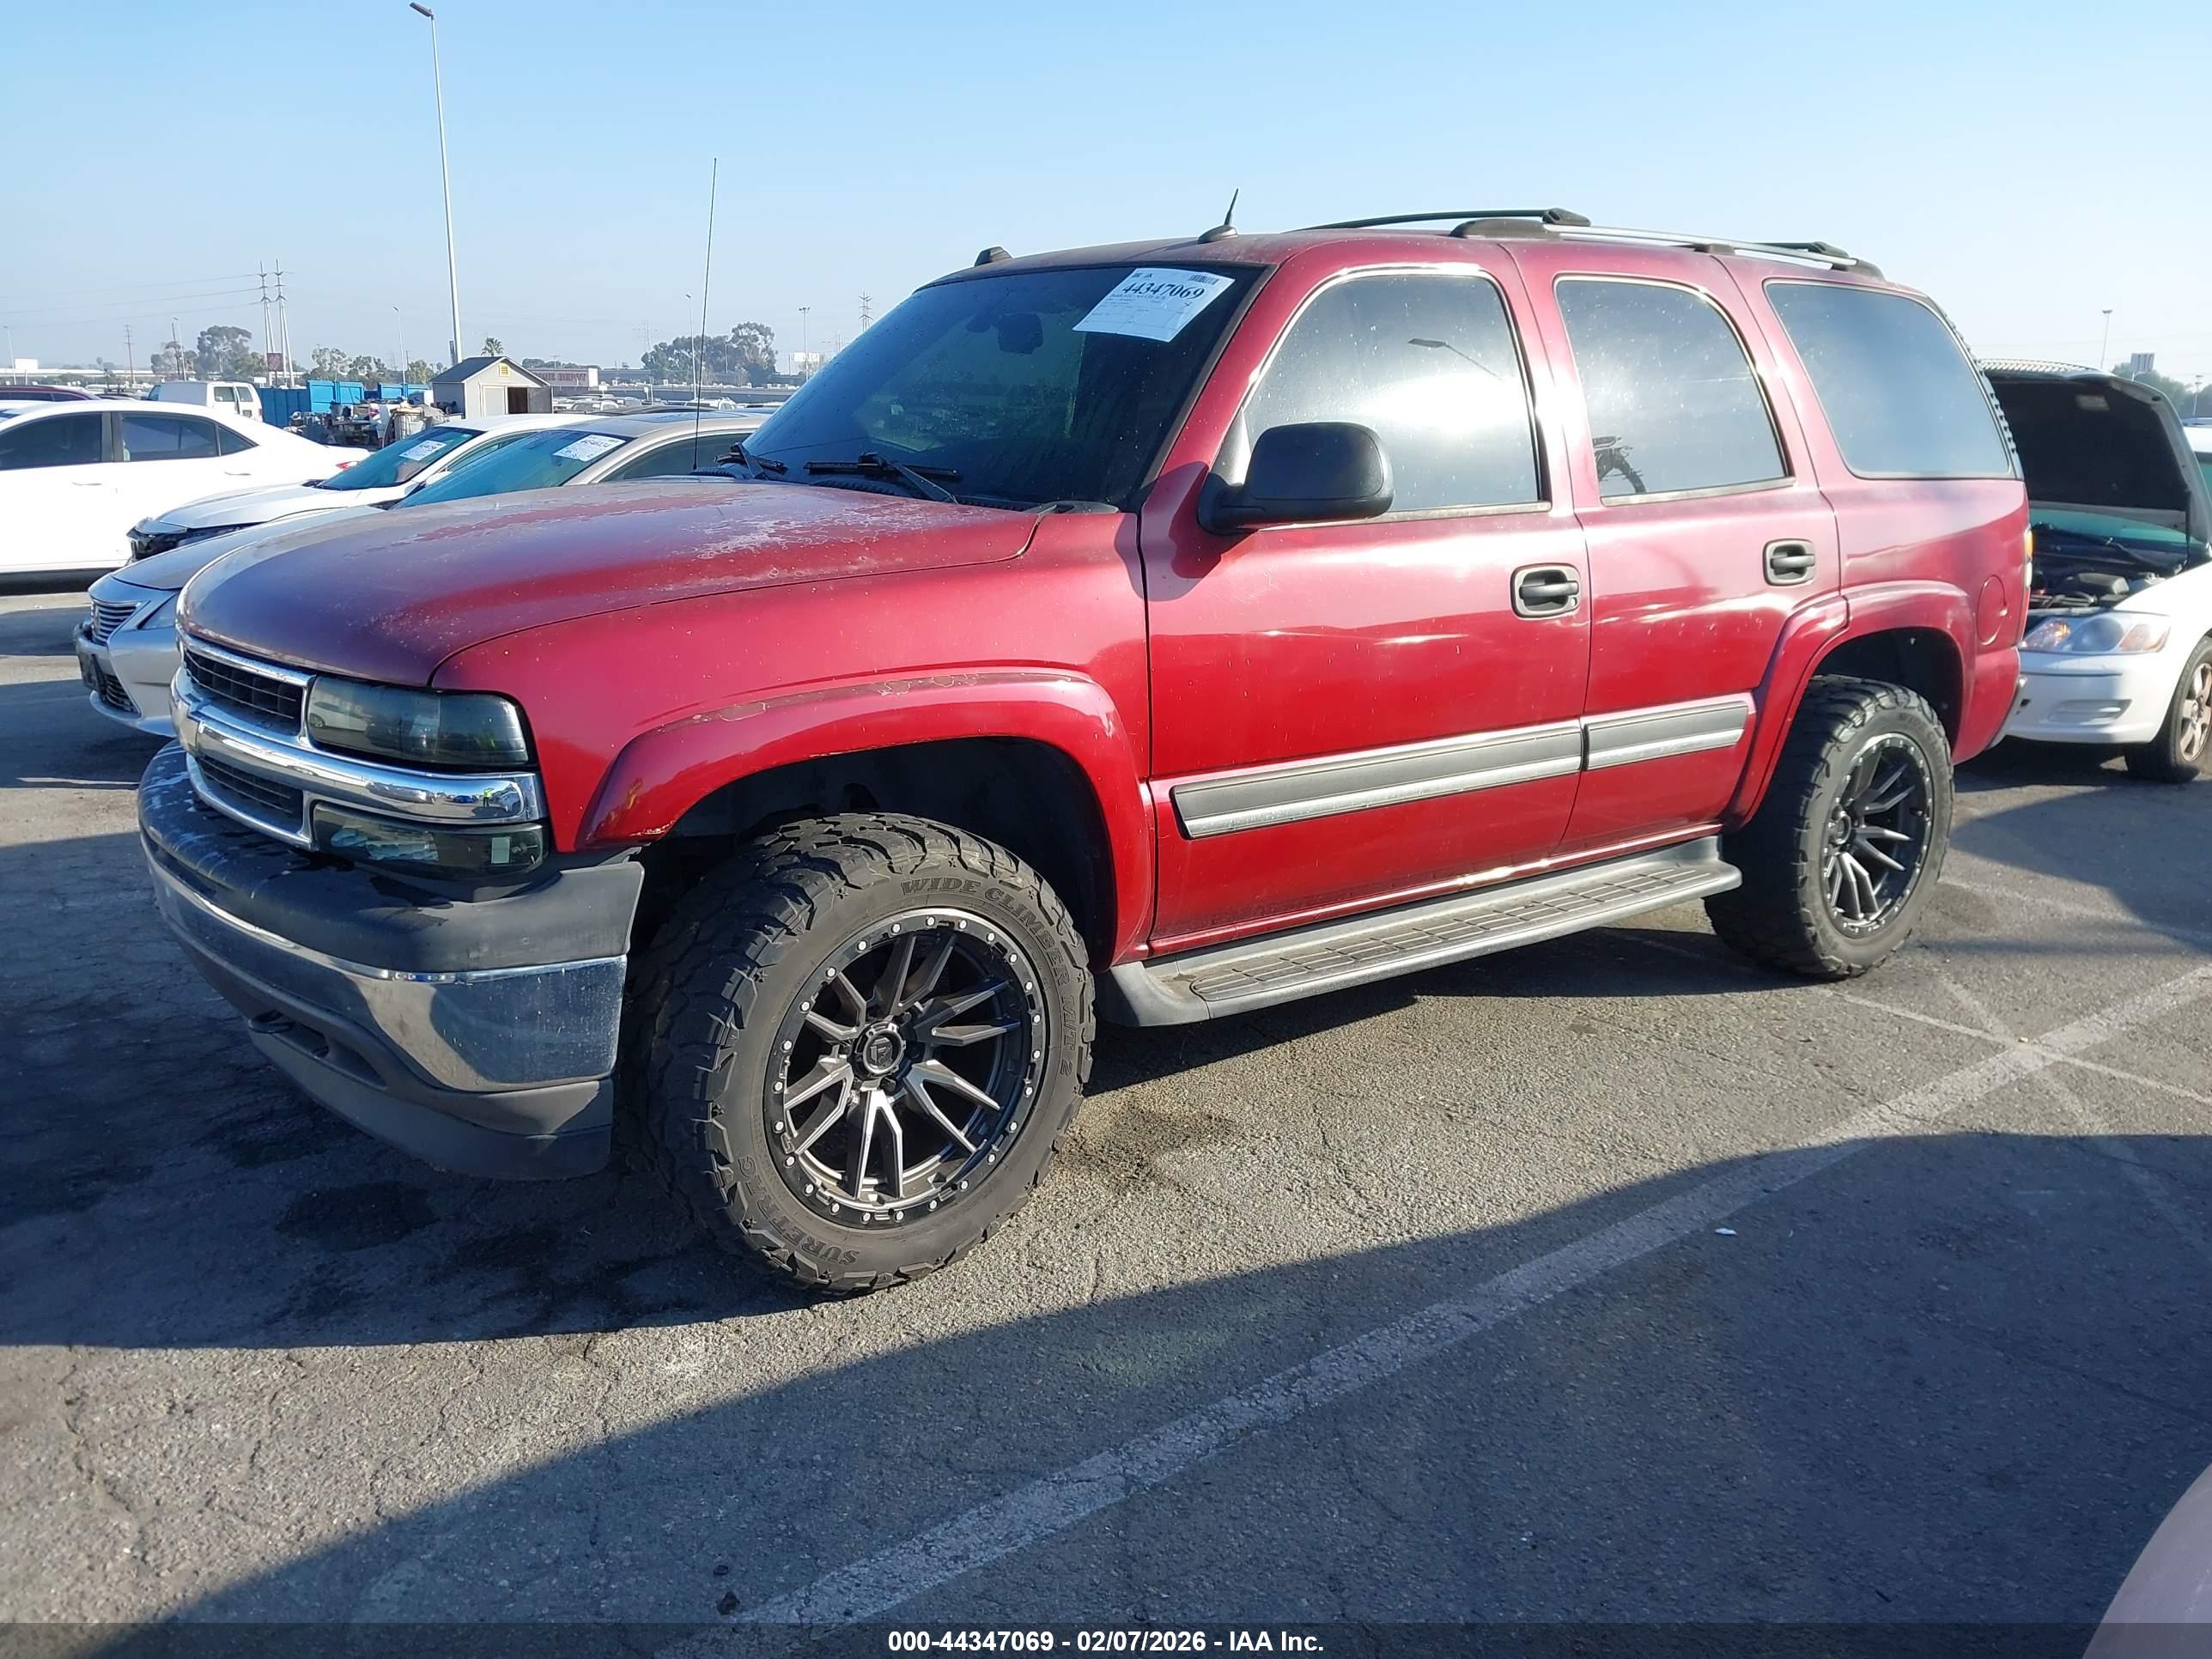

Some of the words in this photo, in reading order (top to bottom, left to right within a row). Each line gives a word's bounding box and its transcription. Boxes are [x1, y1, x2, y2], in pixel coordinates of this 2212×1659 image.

[1122, 282, 1206, 300] 44347069
[900, 877, 981, 896] WIDE
[984, 887, 1070, 987] CLIMBER
[1060, 1059, 1073, 1077] 2
